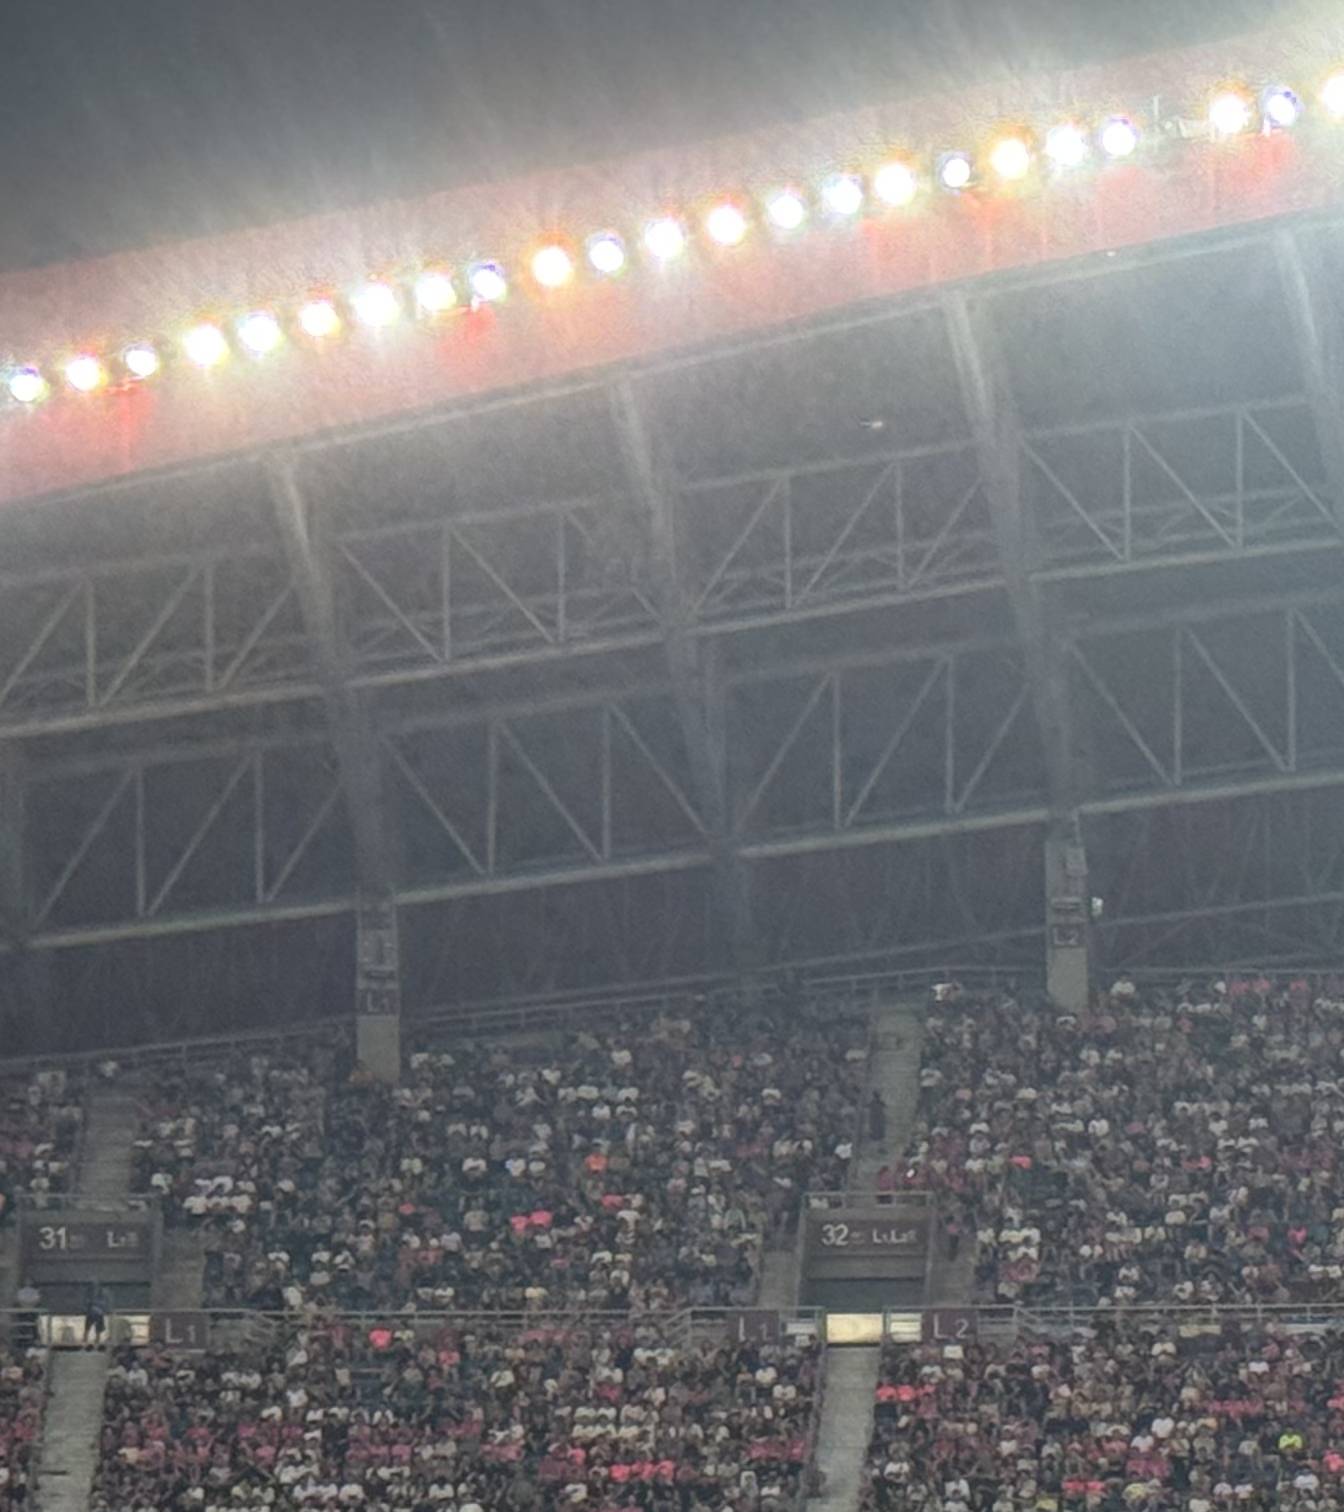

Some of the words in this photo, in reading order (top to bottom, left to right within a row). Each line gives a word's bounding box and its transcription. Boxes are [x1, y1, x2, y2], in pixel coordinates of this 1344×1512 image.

[39, 1227, 67, 1250] 31
[821, 1223, 849, 1246] 32
[164, 1318, 196, 1343] L1
